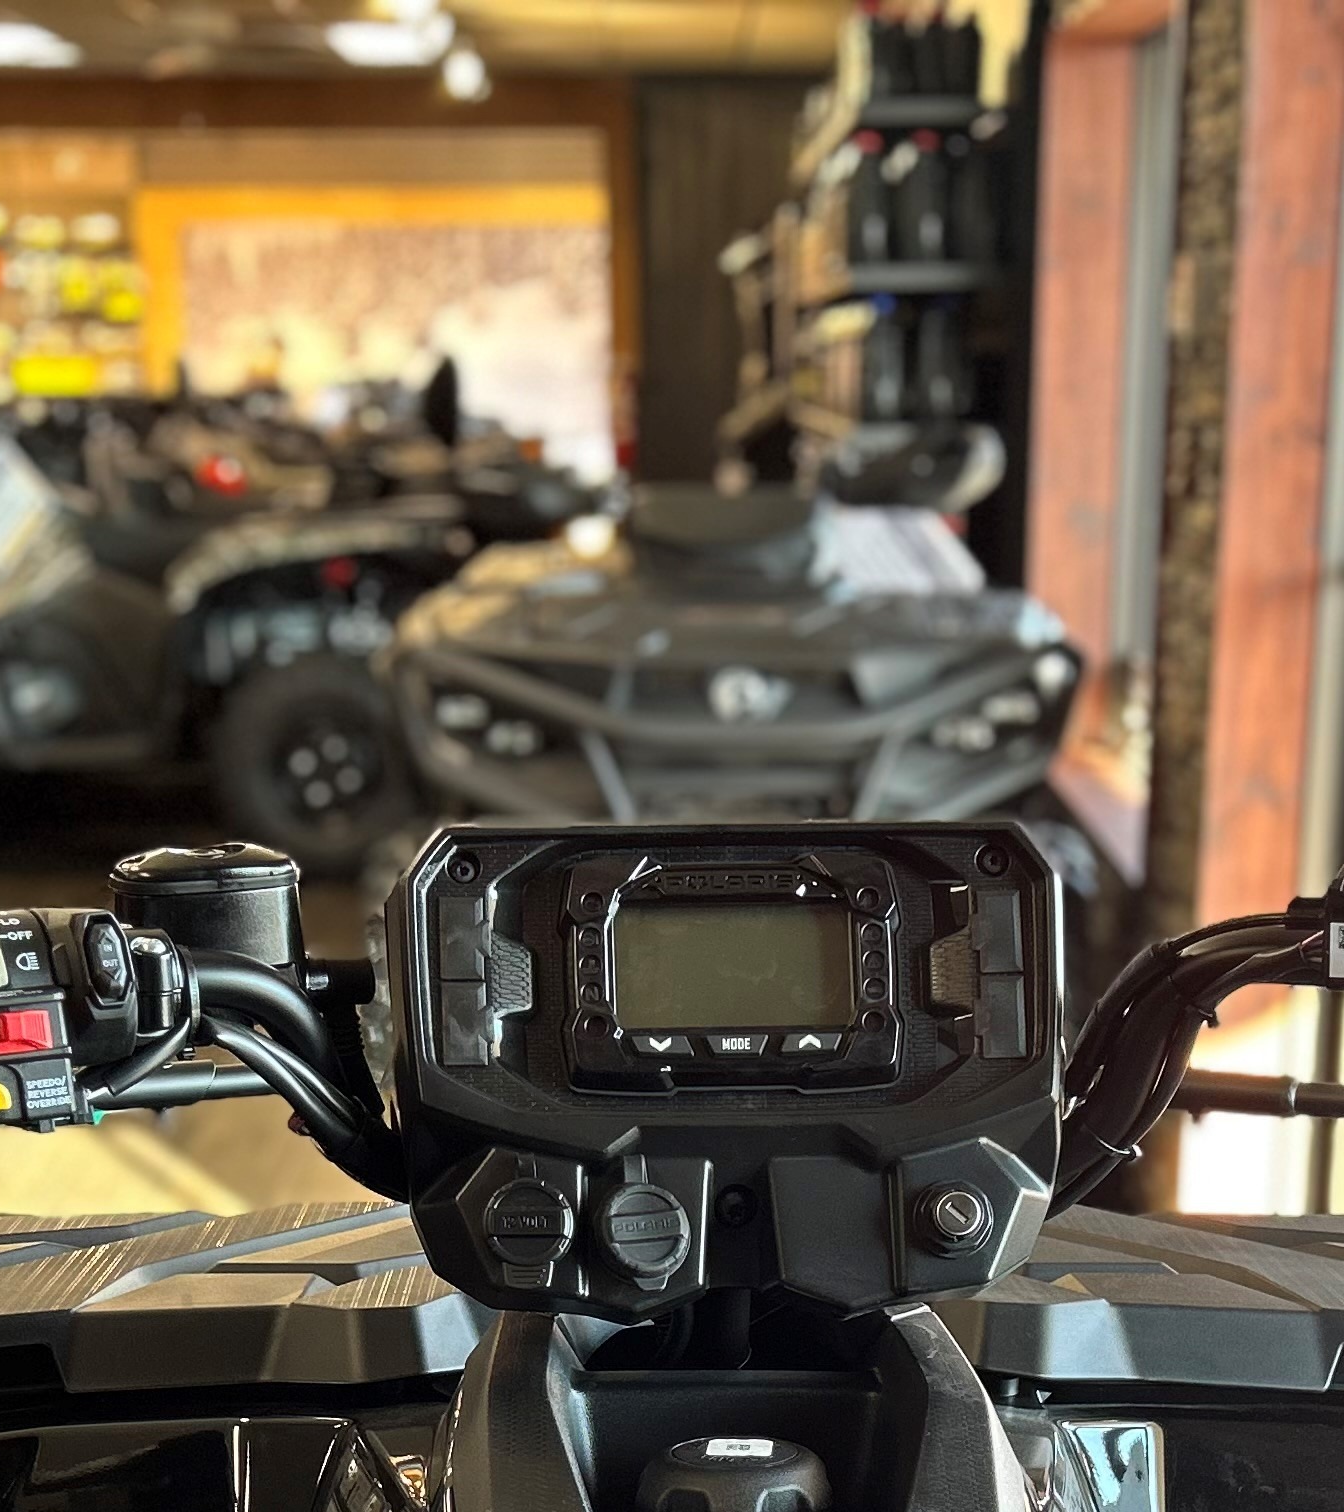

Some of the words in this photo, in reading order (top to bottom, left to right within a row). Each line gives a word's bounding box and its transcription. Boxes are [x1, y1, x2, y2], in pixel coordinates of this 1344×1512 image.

[7, 930, 33, 940] OFF
[103, 944, 113, 952] IN
[102, 959, 119, 967] OUT
[721, 1037, 751, 1050] MODE
[27, 1086, 69, 1100] REVERSE
